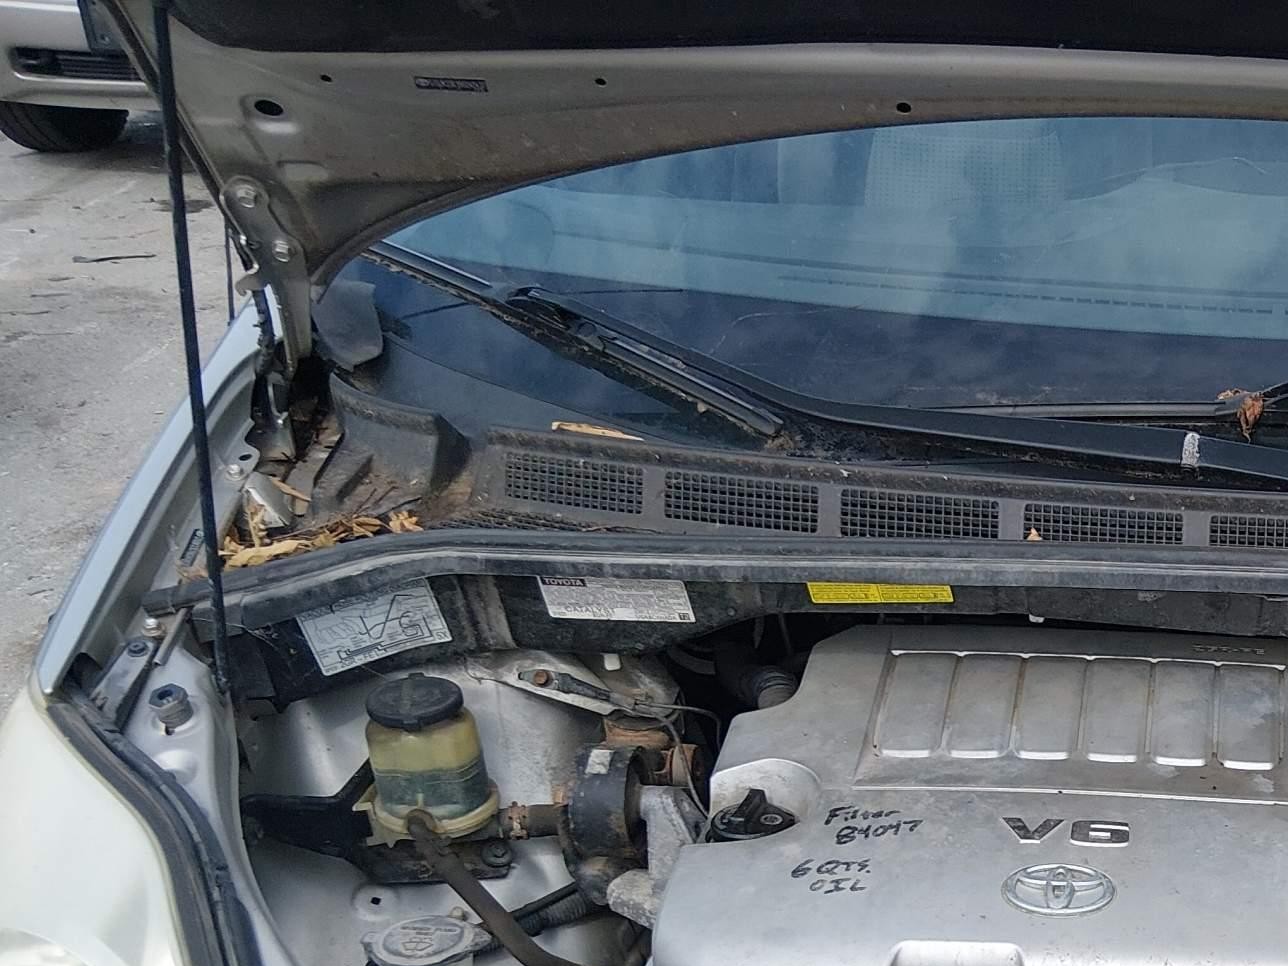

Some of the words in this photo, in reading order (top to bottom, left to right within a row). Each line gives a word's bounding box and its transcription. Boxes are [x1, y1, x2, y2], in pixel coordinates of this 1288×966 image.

[543, 577, 584, 587] TOYOTA
[1002, 817, 1130, 847] V6
[809, 878, 867, 894] OIL
